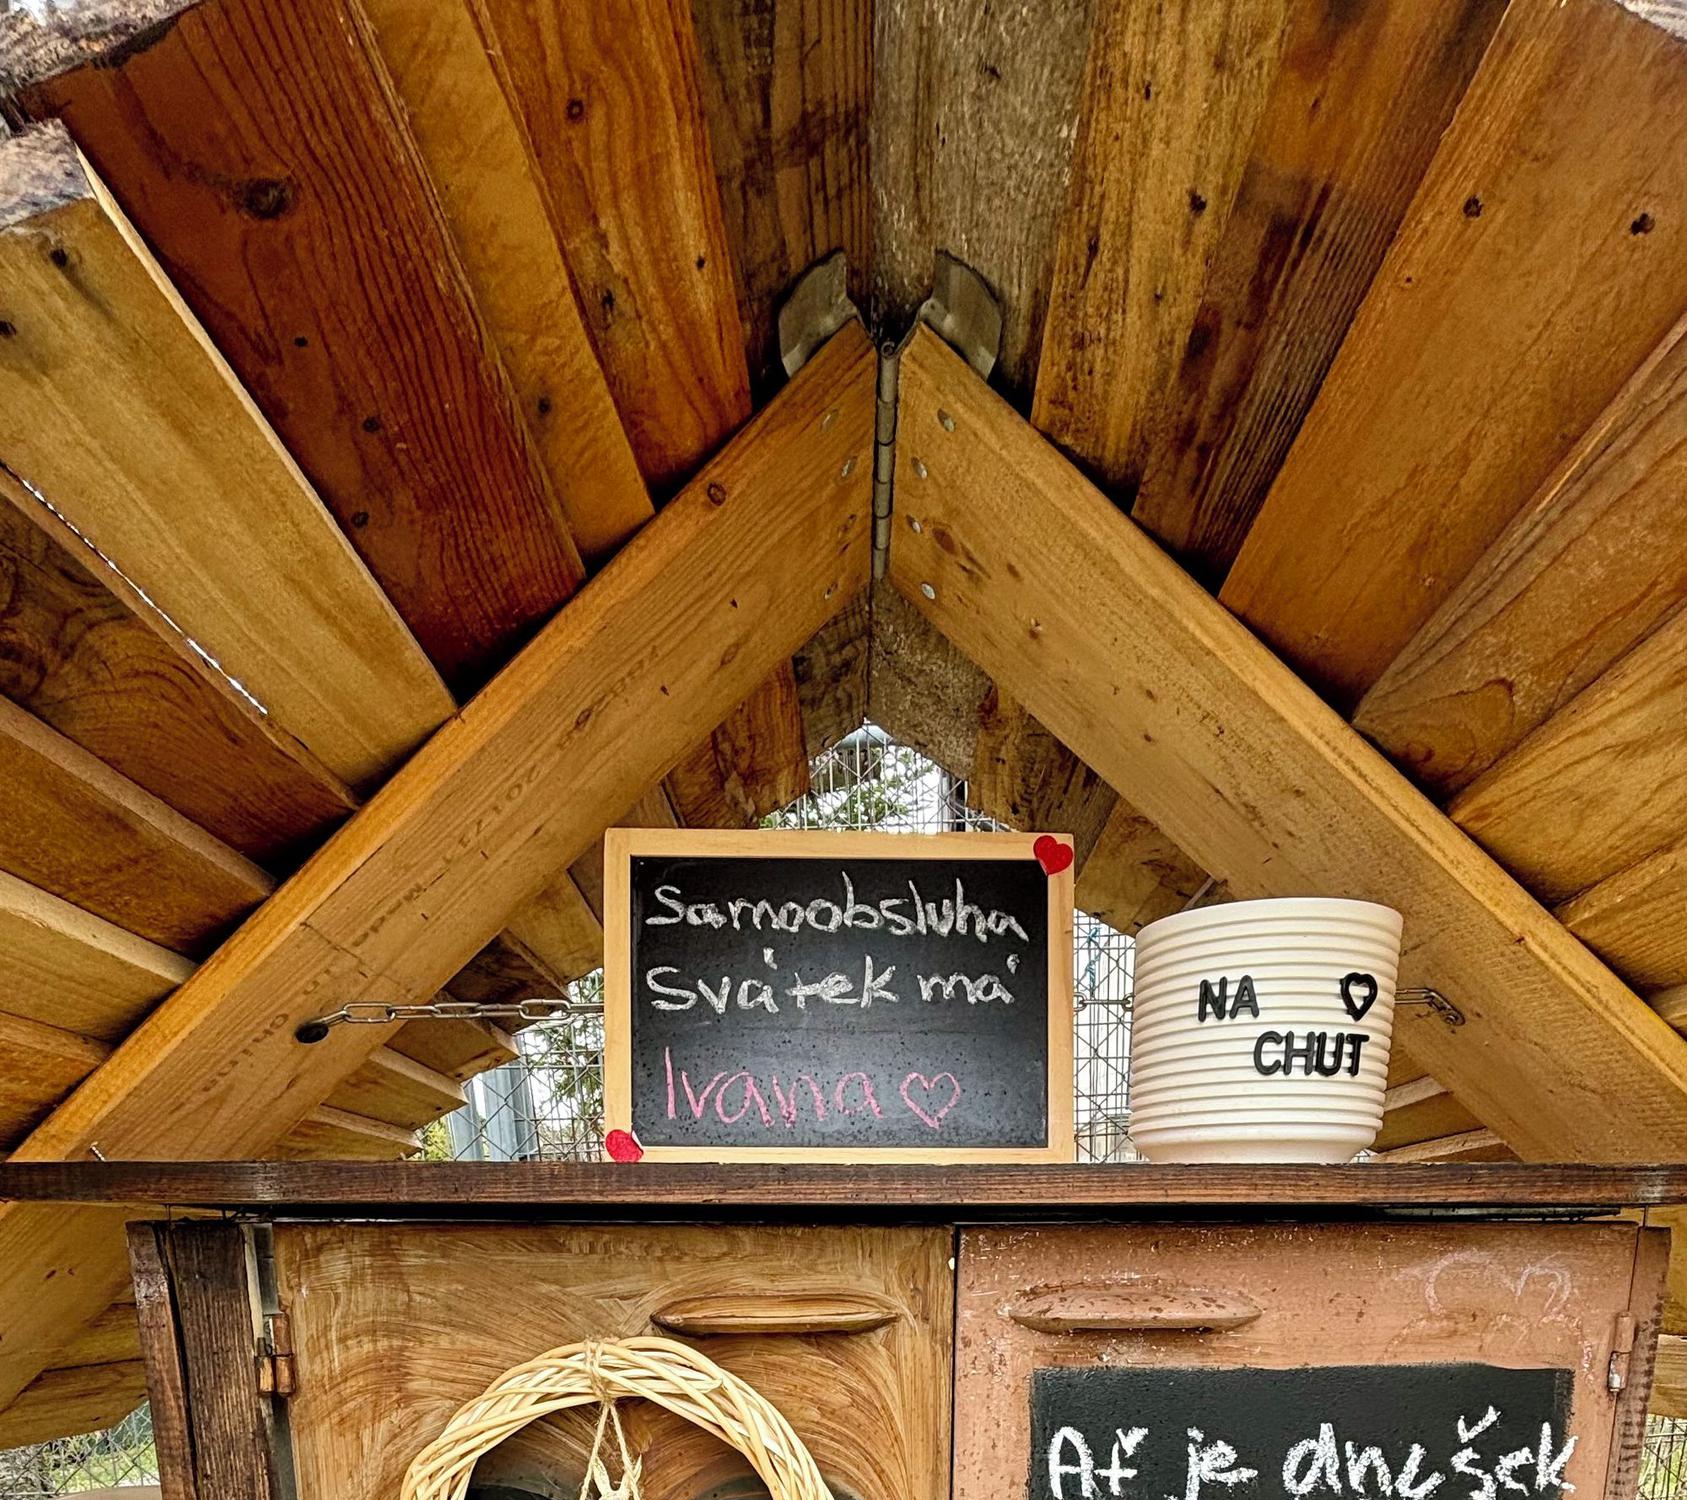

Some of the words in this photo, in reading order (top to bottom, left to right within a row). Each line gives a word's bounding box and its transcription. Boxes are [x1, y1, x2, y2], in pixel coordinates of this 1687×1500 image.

[352, 882, 425, 948] Made
[645, 870, 1030, 943] Samoobsluha
[646, 946, 899, 1014] Svátek
[917, 952, 1021, 1005] má
[1197, 974, 1260, 1023] NA
[202, 1012, 290, 1092] China
[1253, 1030, 1370, 1077] CHUT
[664, 1045, 883, 1128] Ivana
